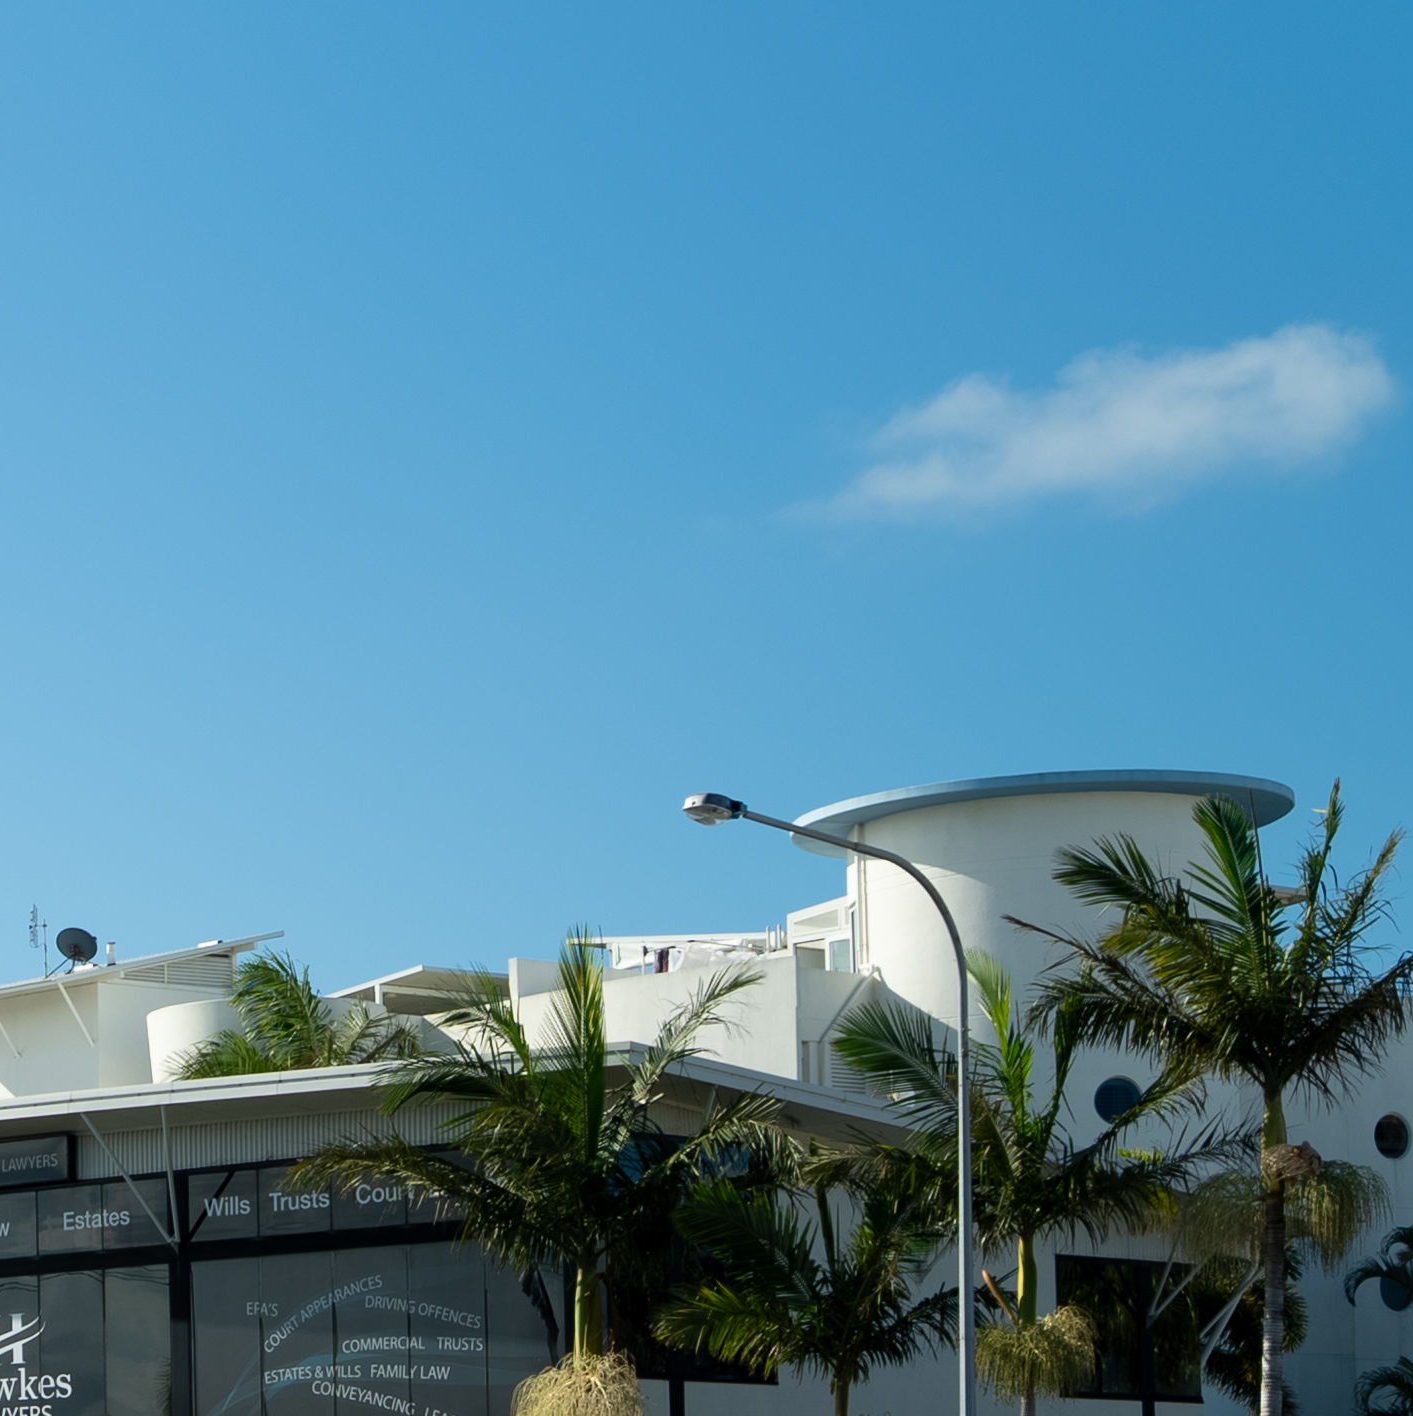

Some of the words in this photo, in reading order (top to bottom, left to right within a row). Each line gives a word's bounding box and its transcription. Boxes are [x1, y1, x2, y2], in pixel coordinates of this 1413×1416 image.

[1, 1153, 58, 1172] LAWYERS
[204, 1196, 251, 1217] Wills
[269, 1189, 330, 1212] Trusts
[62, 1209, 131, 1231] Estates
[263, 1314, 299, 1354] COURT
[299, 1274, 383, 1324] APPEARANCES
[364, 1295, 416, 1315] DRIVING
[417, 1303, 482, 1330] OFFENCES
[341, 1335, 426, 1355] COMMERCIAL
[436, 1336, 485, 1353] TRUSTS
[263, 1365, 313, 1385] ESTATES
[315, 1366, 324, 1380] &
[326, 1364, 362, 1380] WILLS
[369, 1363, 416, 1380] FAMILY
[420, 1364, 451, 1381] LAW
[311, 1379, 417, 1416] CONVEYANCING
